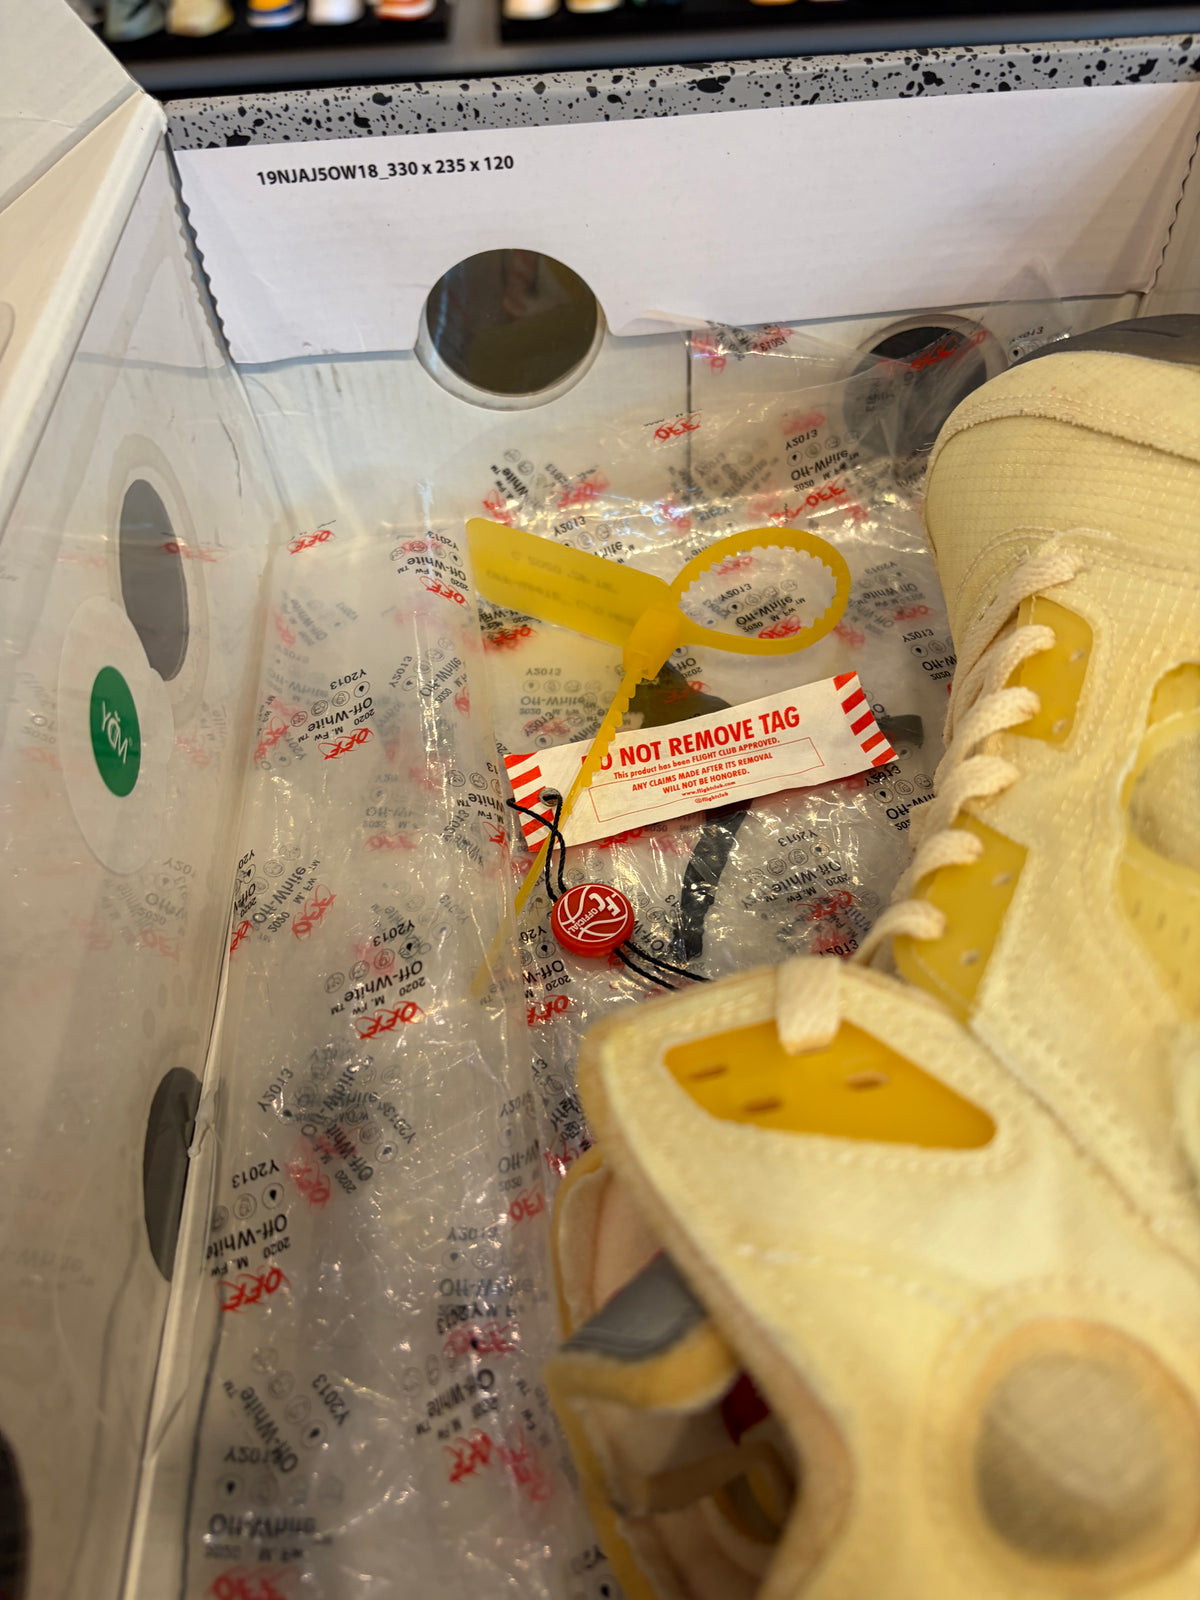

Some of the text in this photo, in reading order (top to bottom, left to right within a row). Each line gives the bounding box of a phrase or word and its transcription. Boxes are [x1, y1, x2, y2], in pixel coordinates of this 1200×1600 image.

[421, 163, 433, 175] x
[435, 158, 466, 173] 235
[470, 161, 480, 172] x
[484, 155, 514, 170] 120
[427, 530, 459, 551] Y2013
[450, 577, 469, 591] 2020
[329, 668, 367, 690] Y2013
[353, 708, 375, 726] 2020
[318, 727, 375, 760] OFF
[619, 740, 662, 767] NOT
[668, 718, 755, 757] REMOVE
[758, 706, 800, 735] TAG
[613, 737, 780, 780] This product has been FLIGHT CLUB APPROVED.
[631, 752, 774, 792] ANY CLAIMS MADE AFTER ITS REMOVAL
[662, 768, 750, 794] WILL NOT BE HONORED.
[588, 892, 621, 917] FC
[567, 907, 599, 933] OFFICIAL
[372, 919, 415, 947] Y2013
[520, 925, 547, 942] Y20
[522, 960, 564, 984] Off-W
[545, 974, 572, 992] 2020
[399, 976, 426, 997] 2020
[355, 1001, 426, 1040] OFF
[231, 1159, 280, 1189] Y2013
[263, 1236, 291, 1259] 2020
[215, 1265, 291, 1313] OFF
[312, 1373, 352, 1427] Y2013
